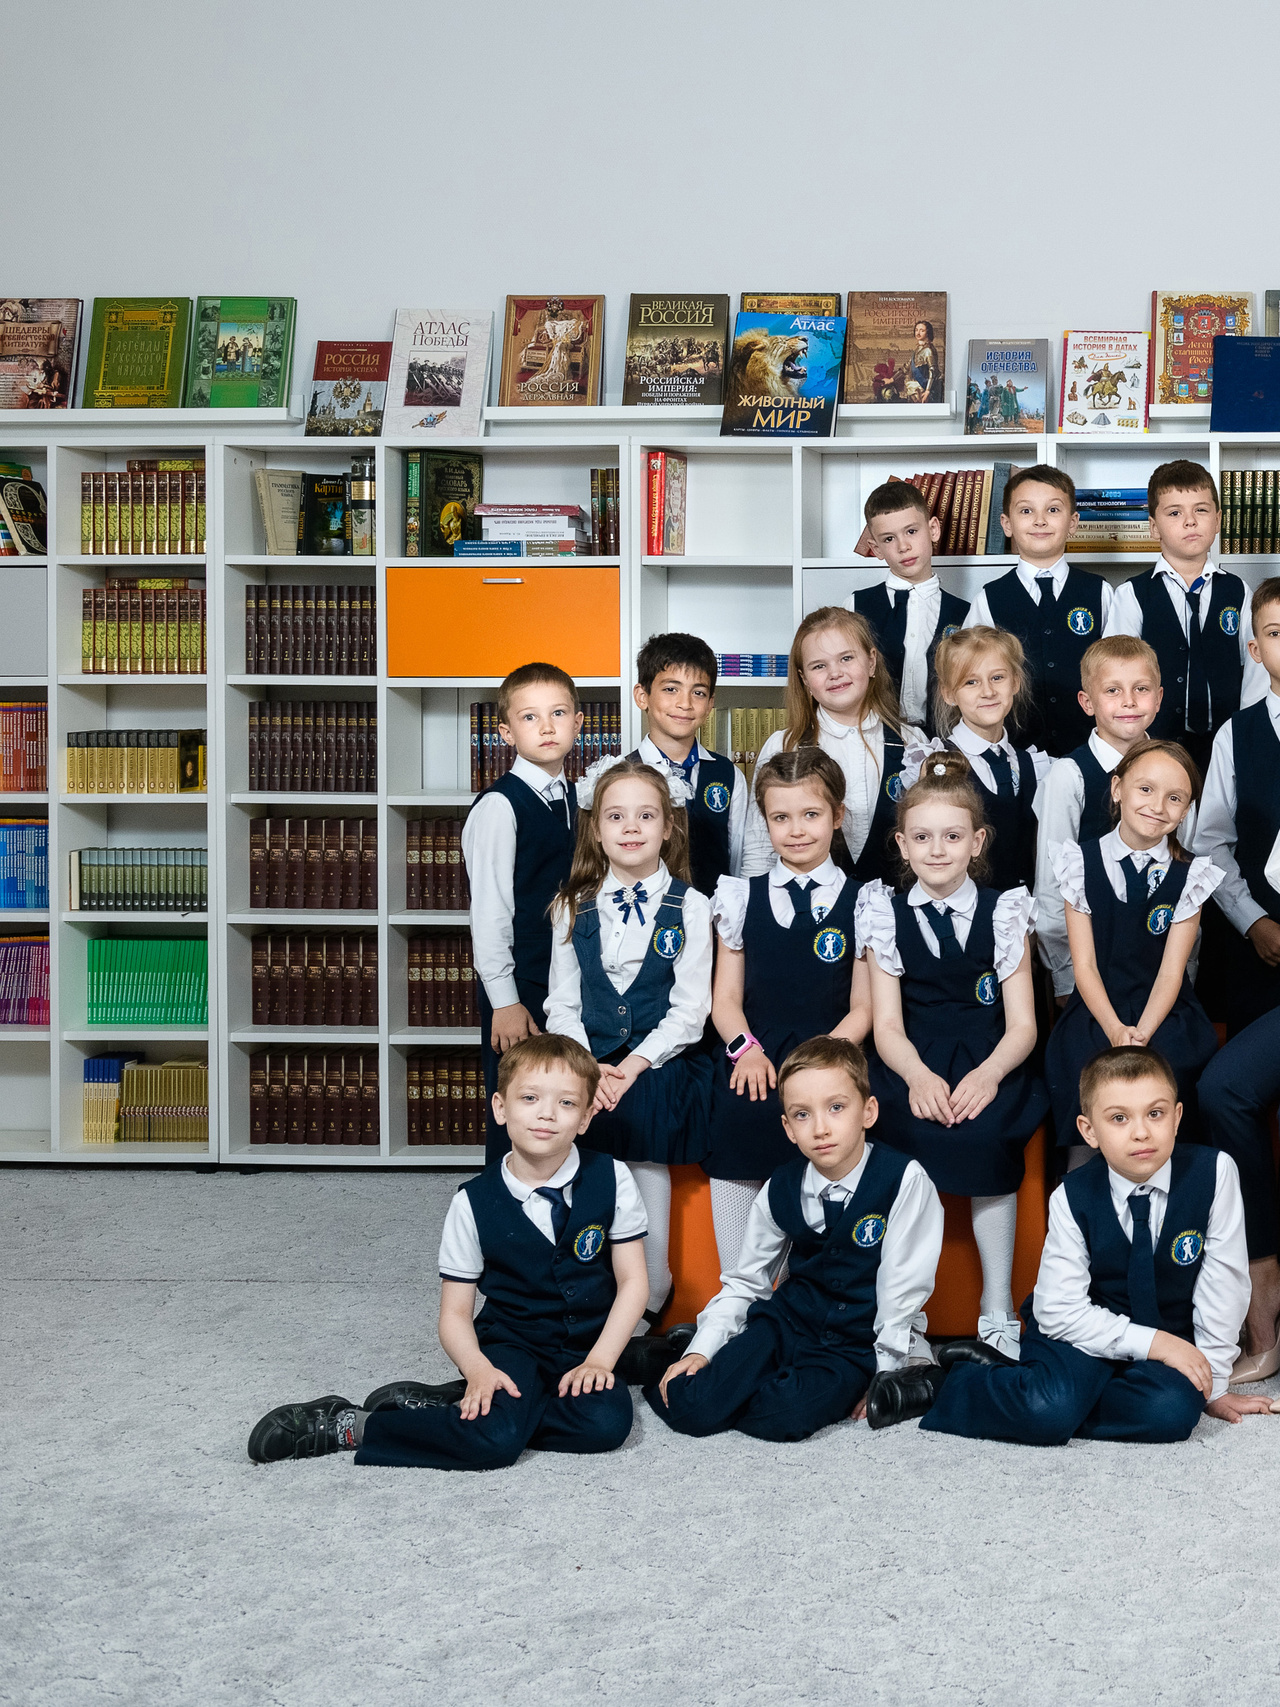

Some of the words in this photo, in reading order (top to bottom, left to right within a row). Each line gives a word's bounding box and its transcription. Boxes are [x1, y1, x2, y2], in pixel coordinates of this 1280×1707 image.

[652, 301, 704, 310] ВЕЛИКАЯ
[639, 307, 715, 324] РОССИЯ
[864, 308, 926, 317] РОССИЙСКОЙ
[5, 326, 50, 334] ШЕДЕВРЫ
[412, 321, 471, 335] АТЛАС
[1114, 344, 1138, 352] ДАТАХ
[324, 353, 380, 365] РОССИЯ
[986, 350, 1031, 361] ИСТОРИЯ
[981, 361, 1037, 373] ОТЕЧЕСТВА
[639, 376, 705, 385] РОССИЙСКАЯ
[519, 382, 579, 392] РОССИЯ
[648, 385, 697, 393] ИМПЕРИЯ:
[522, 393, 574, 401] ДЕРЖАВНАЯ
[737, 394, 825, 409] ЖИВОТНЫЙ
[752, 409, 811, 429] МИР
[939, 486, 951, 519] ШОЛОХОВ
[953, 485, 963, 519] ШОЛОХОВ
[972, 484, 981, 518] ШОЛОХОВ
[958, 519, 967, 549] МИХАИЛ
[963, 483, 972, 519] ШОЛОХОВ
[949, 520, 958, 549] МИХАИЛ
[968, 519, 977, 549] МИХАИЛ
